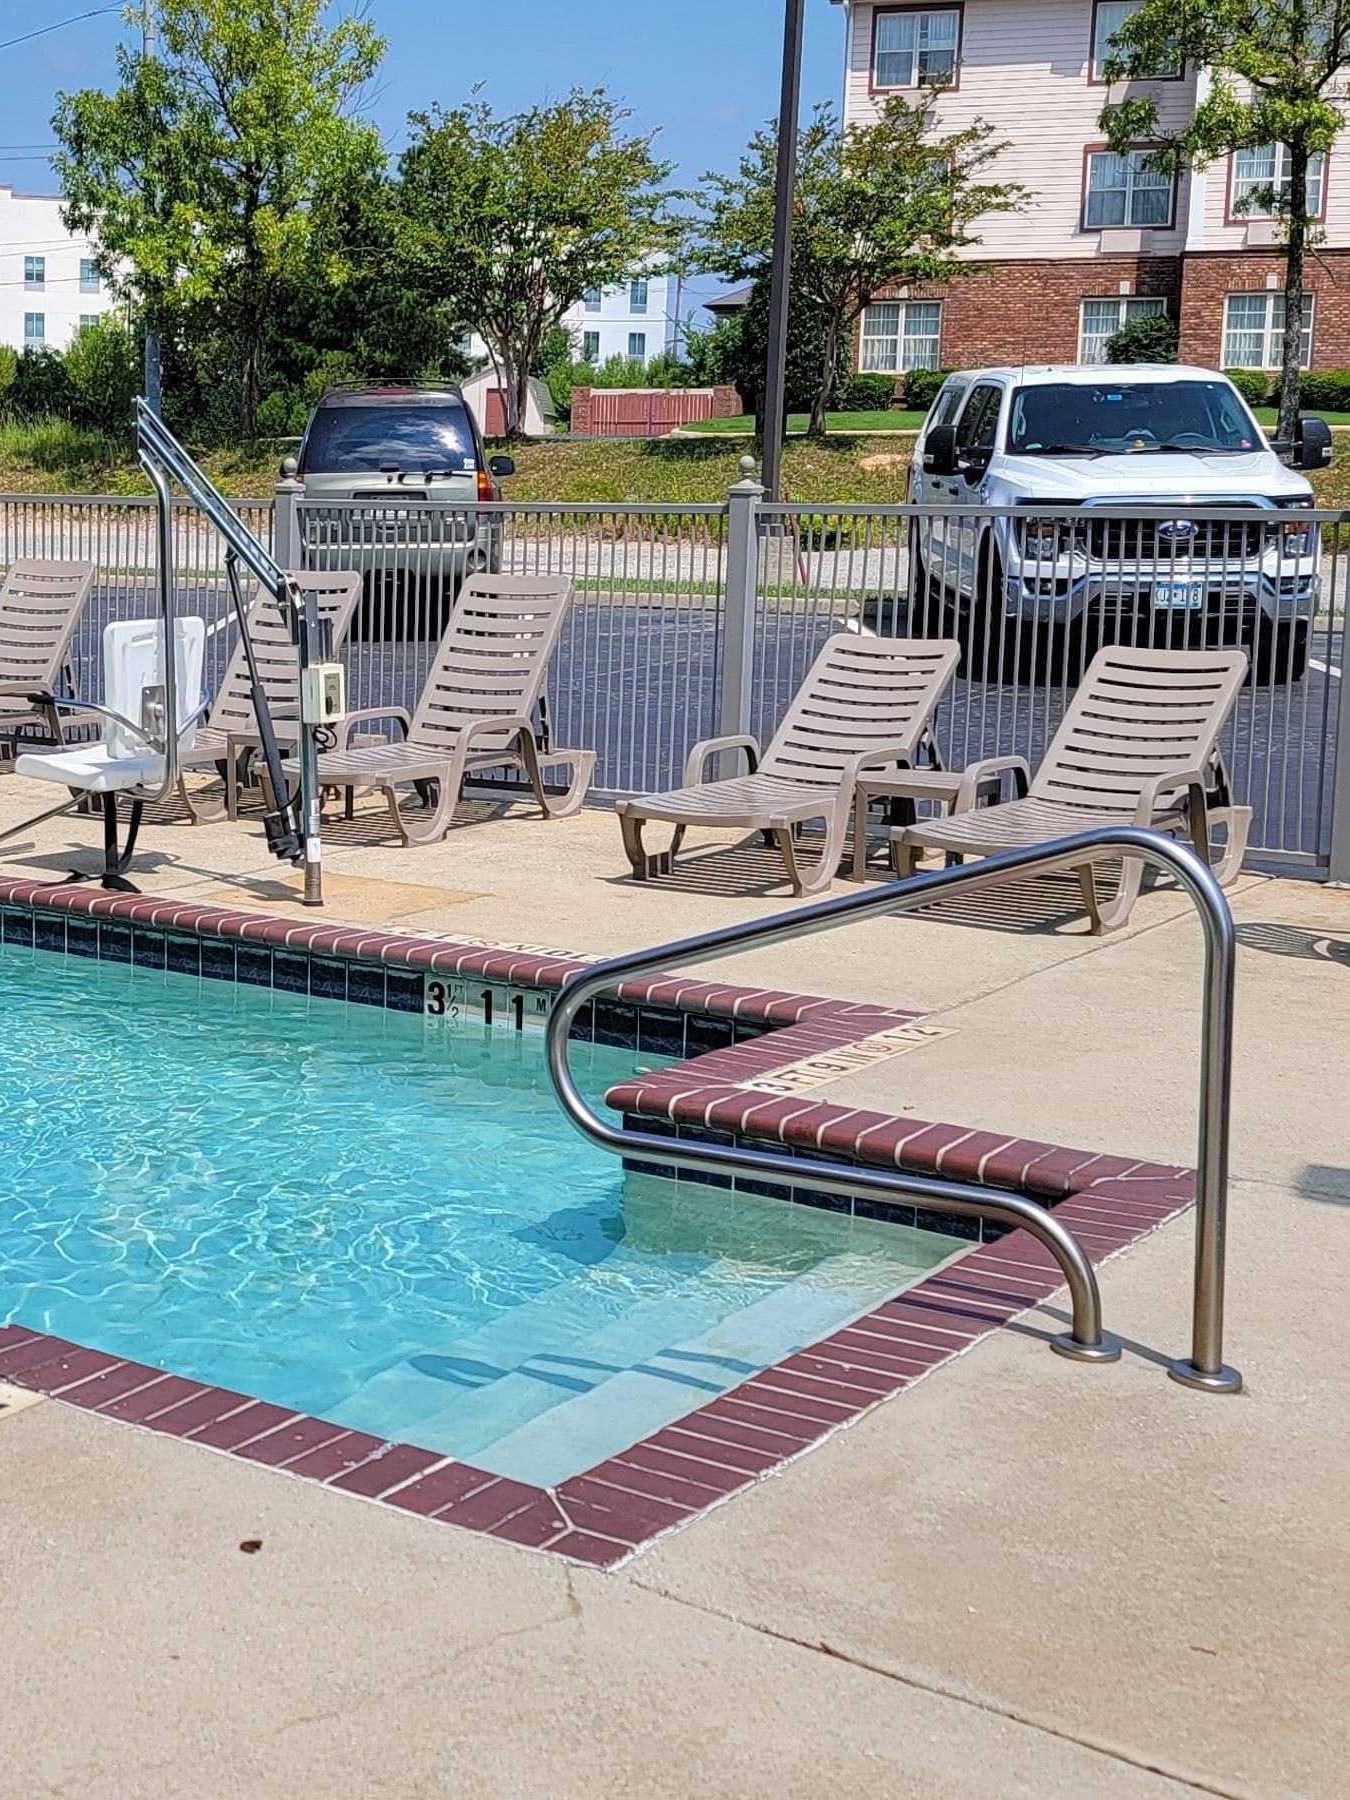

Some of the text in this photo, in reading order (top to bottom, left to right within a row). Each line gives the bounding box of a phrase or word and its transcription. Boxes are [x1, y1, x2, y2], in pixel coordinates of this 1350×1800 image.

[536, 998, 547, 1013] M
[807, 1061, 850, 1073] 9
[773, 1069, 827, 1086] FT
[752, 1080, 795, 1092] 3
